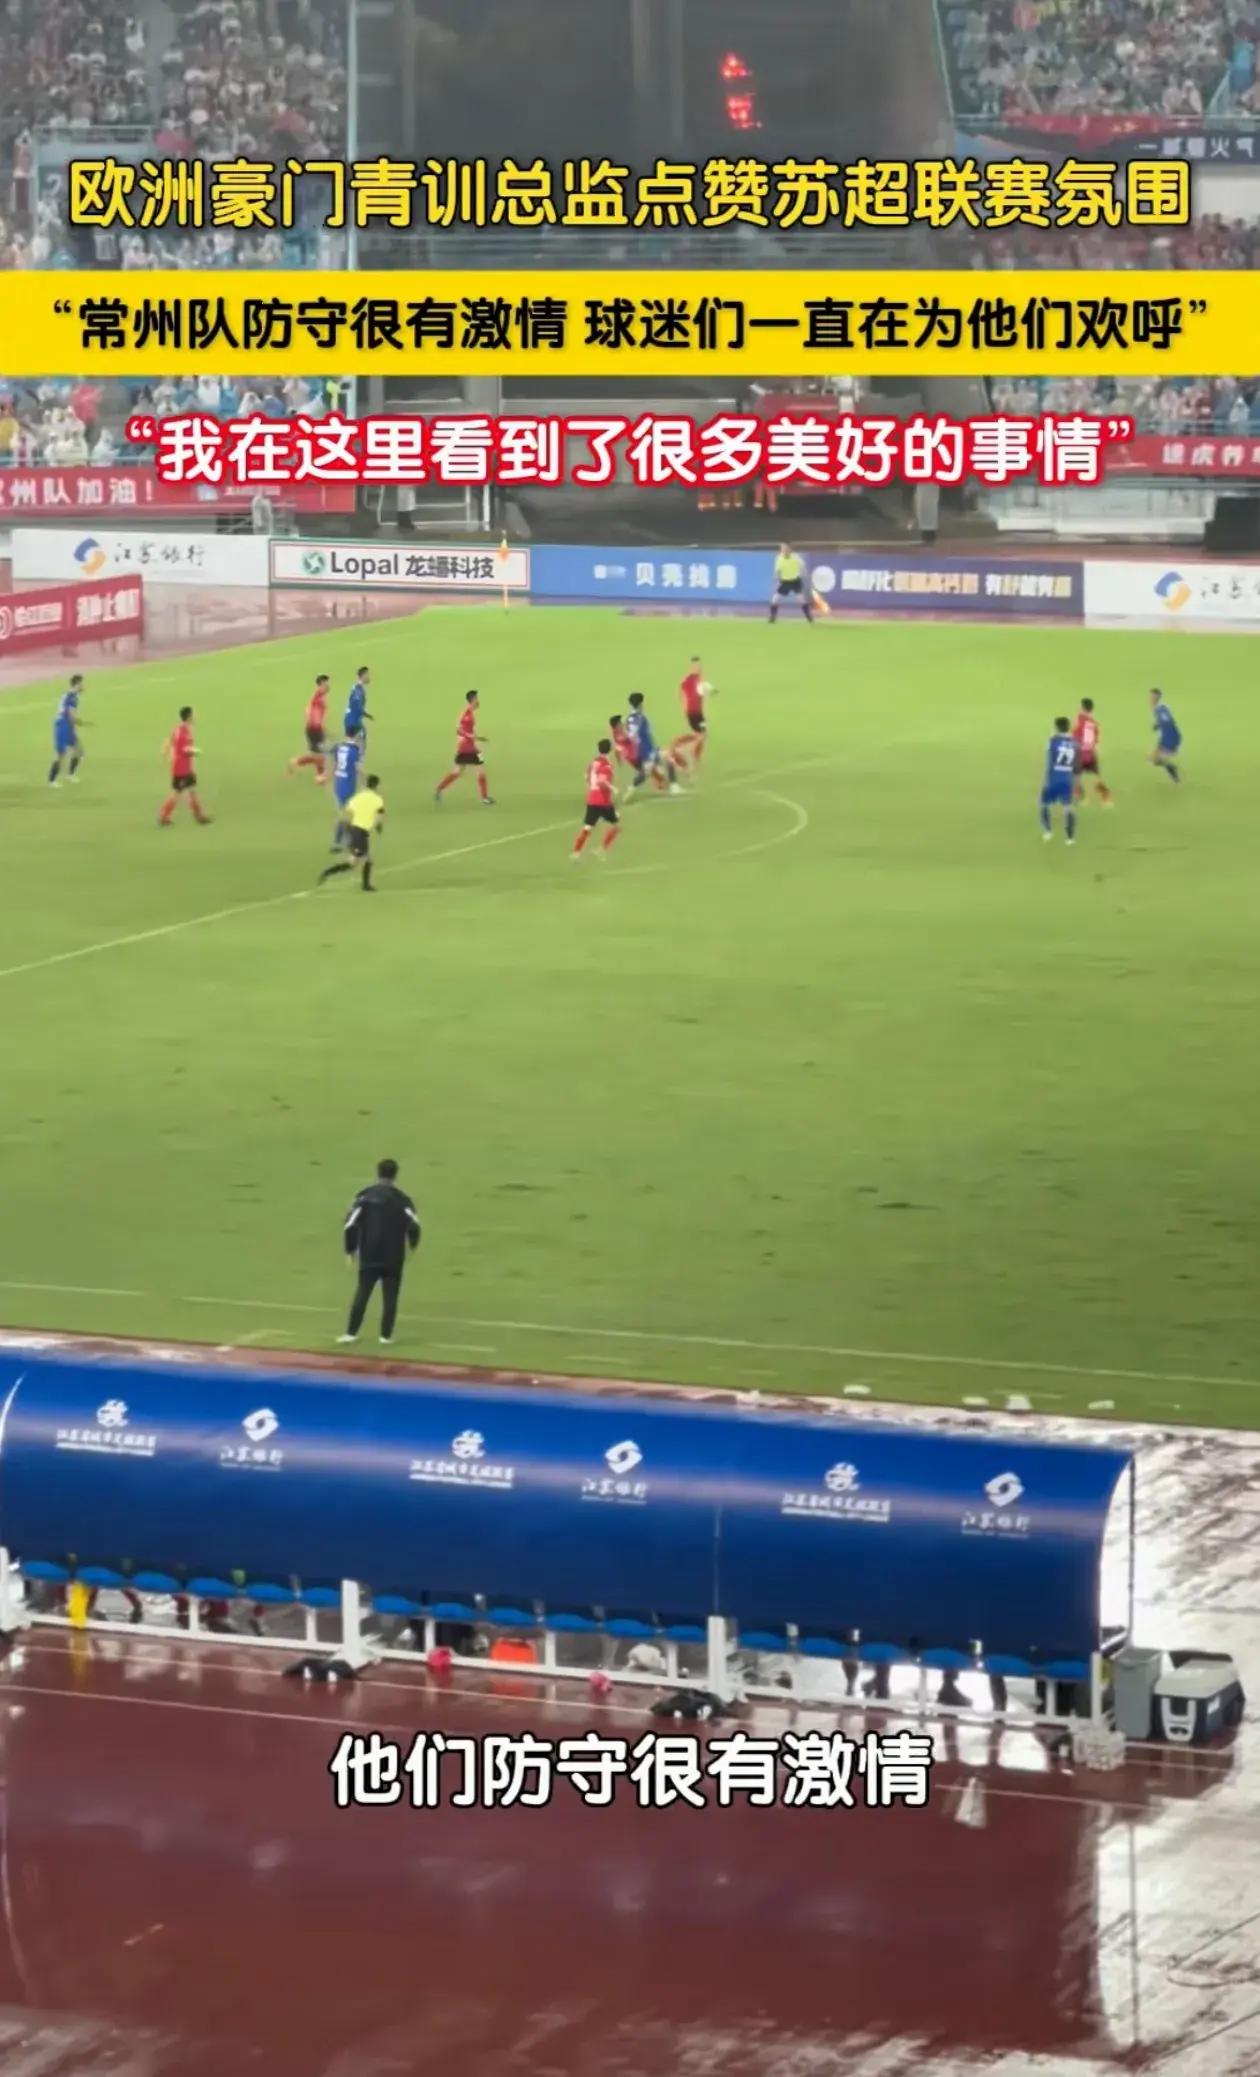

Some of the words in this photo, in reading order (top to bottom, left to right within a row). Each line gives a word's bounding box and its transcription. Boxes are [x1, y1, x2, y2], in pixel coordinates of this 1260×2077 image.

[0, 477, 155, 507] 州队加油！
[331, 551, 399, 579] Lopal
